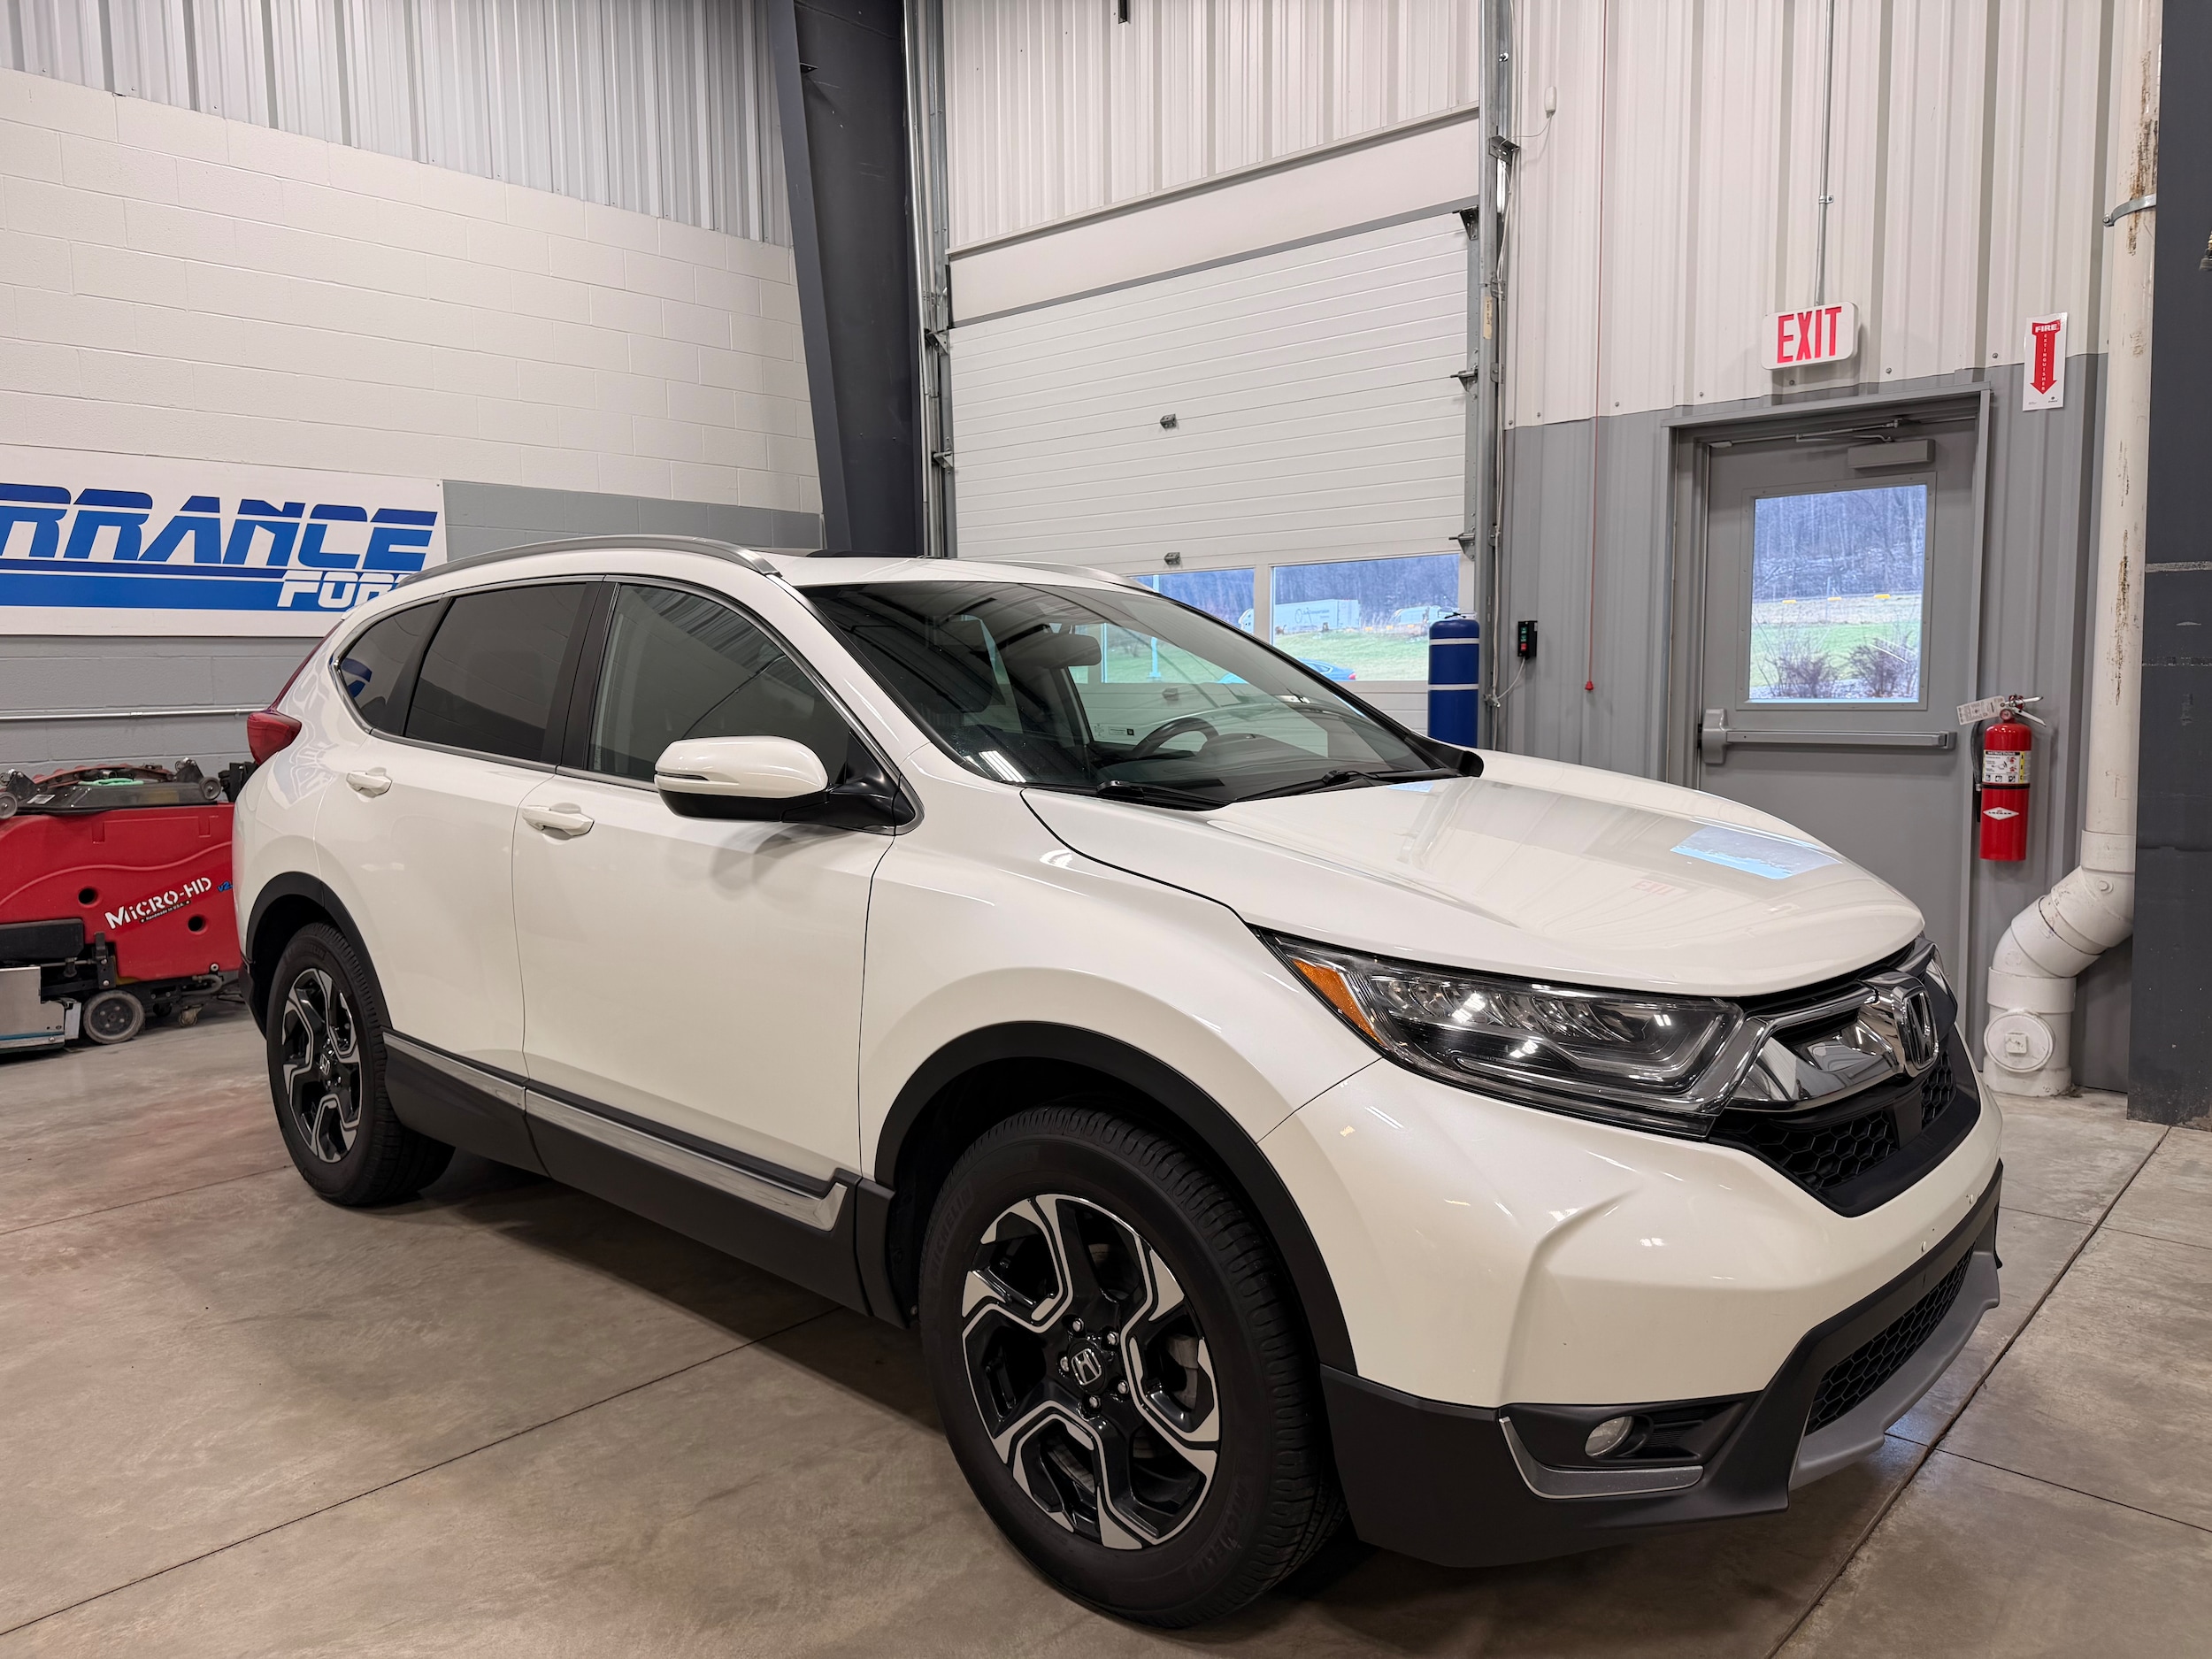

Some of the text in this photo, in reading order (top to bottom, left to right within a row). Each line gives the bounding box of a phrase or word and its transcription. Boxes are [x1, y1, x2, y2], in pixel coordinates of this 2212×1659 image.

[1777, 306, 1842, 364] EXIT
[2035, 324, 2058, 334] FIRE
[277, 570, 411, 609] FOR
